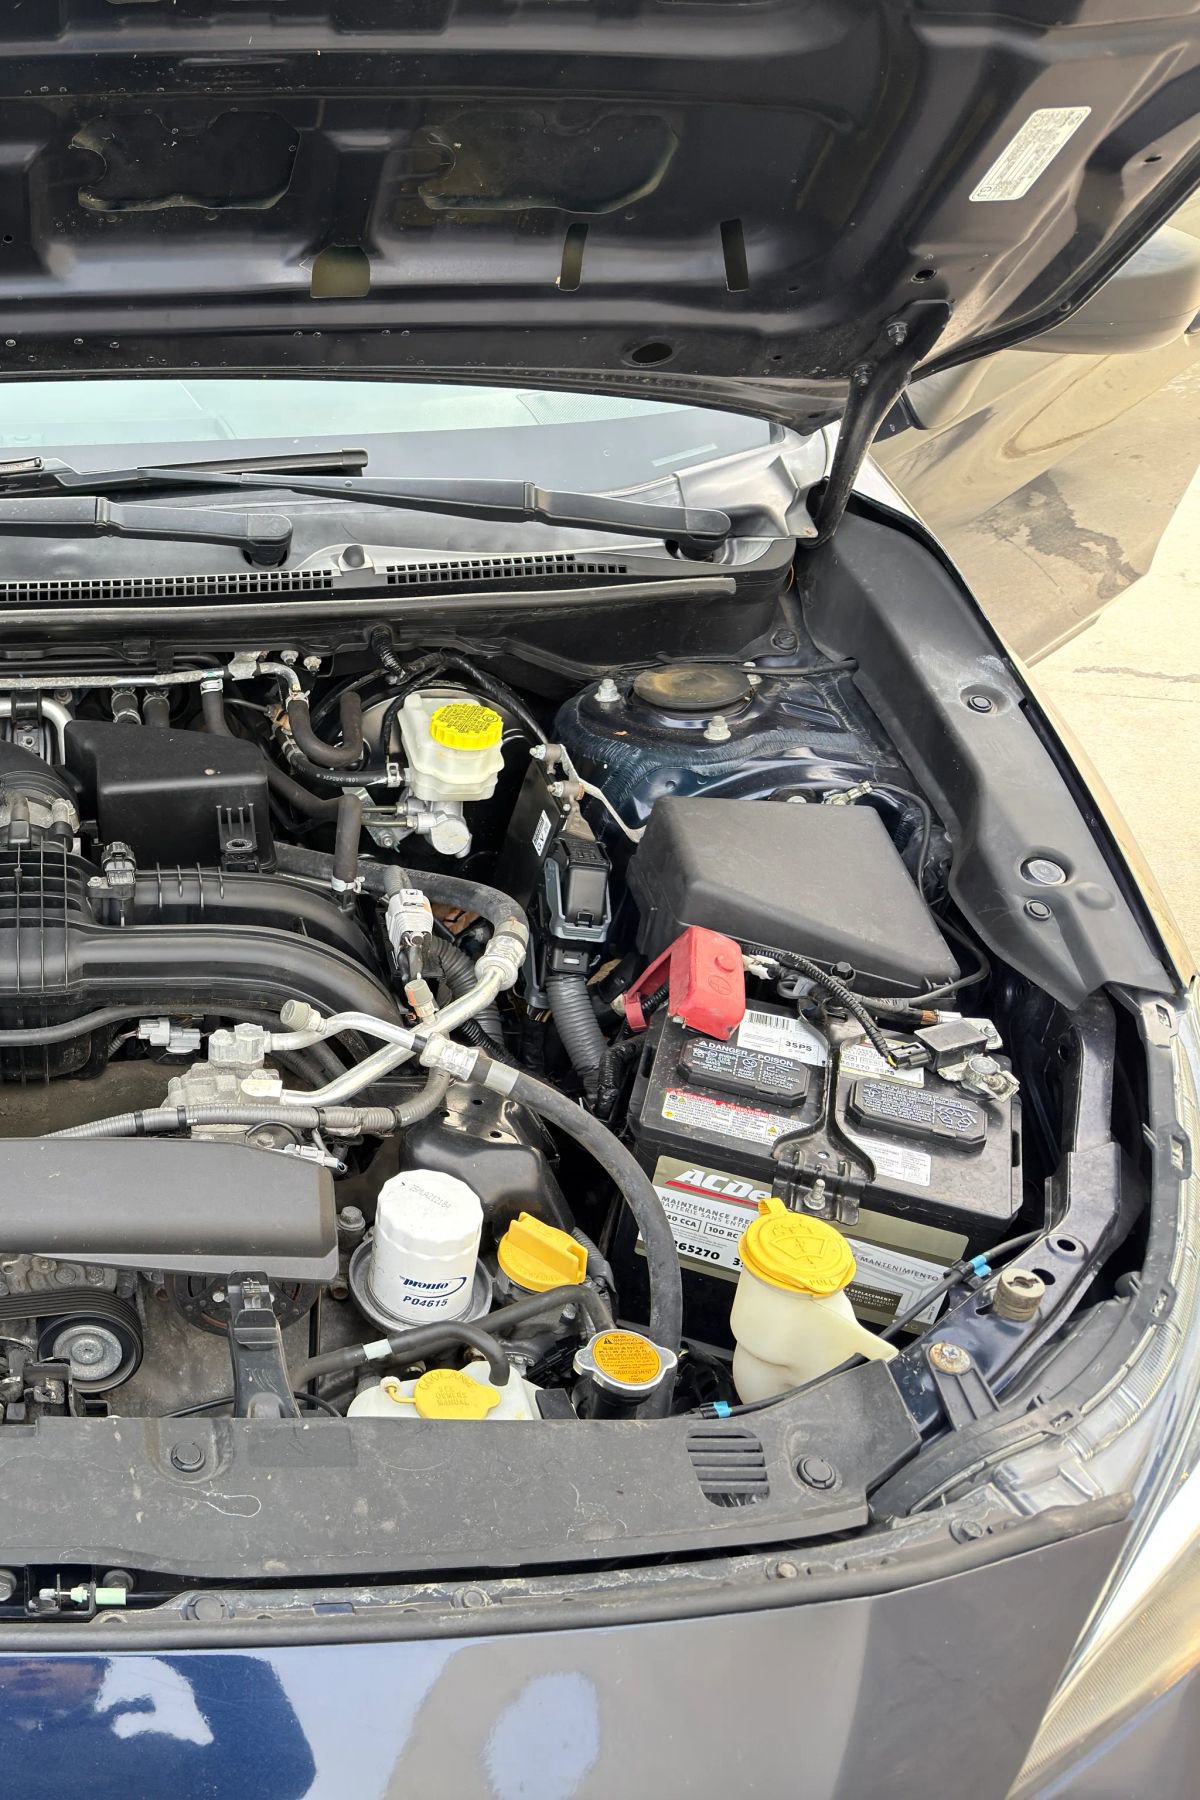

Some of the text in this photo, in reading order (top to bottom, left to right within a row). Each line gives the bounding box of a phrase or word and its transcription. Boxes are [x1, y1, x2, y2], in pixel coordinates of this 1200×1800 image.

[785, 1040, 813, 1052] 35PS
[708, 1042, 748, 1057] DANGER
[757, 1054, 794, 1067] POISON
[674, 1168, 772, 1202] ACDe
[661, 1196, 730, 1219] MAINTENANCE
[667, 1214, 697, 1228] 40 CCA
[701, 1213, 722, 1223] SANS
[708, 1226, 739, 1239] 100 RC
[860, 1256, 939, 1281] MANTENIMIENTO
[403, 1278, 449, 1290] pronto
